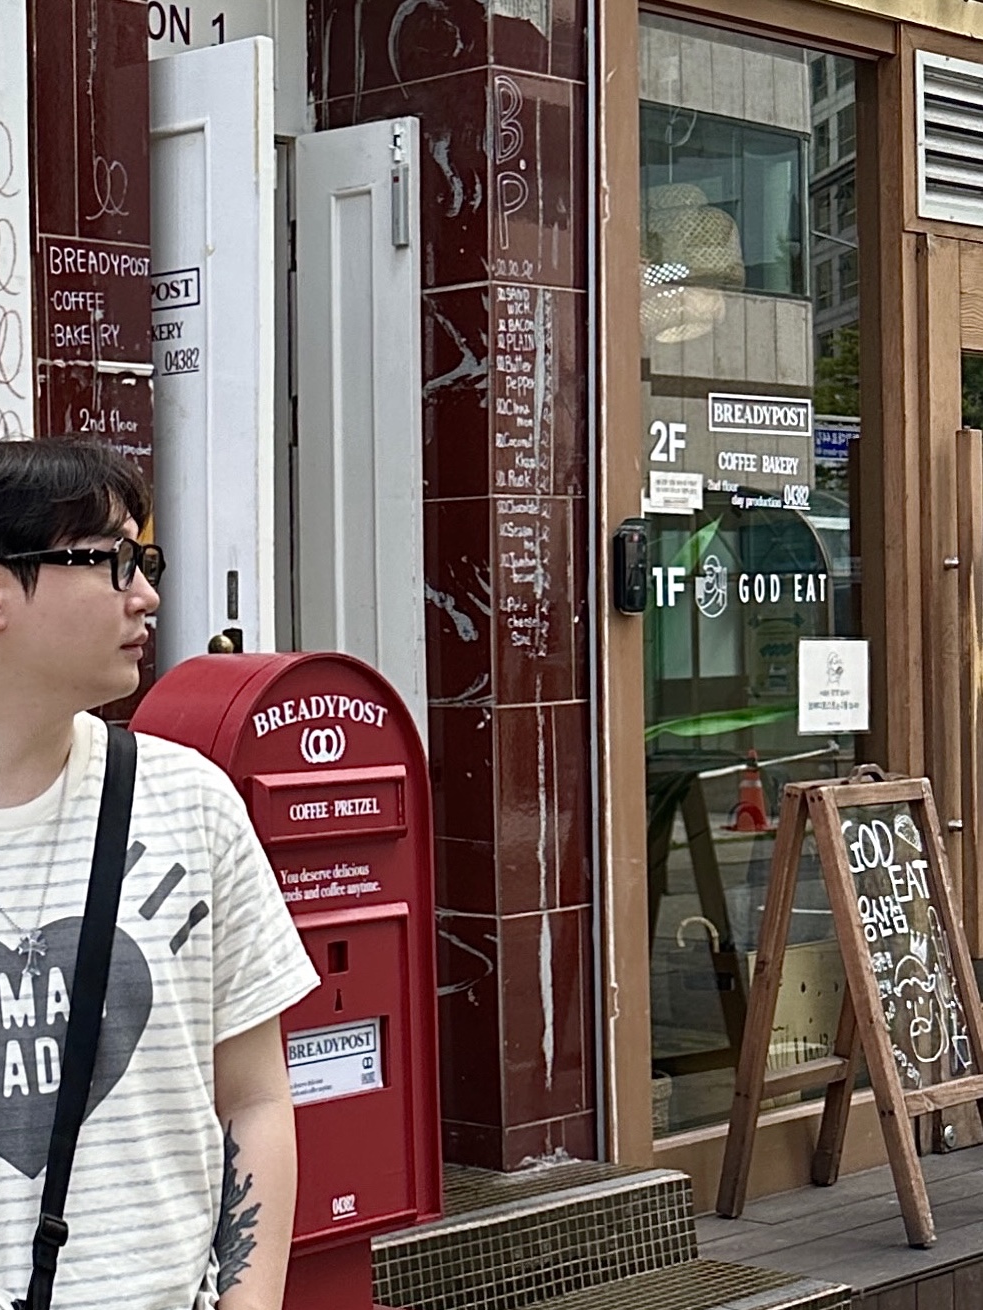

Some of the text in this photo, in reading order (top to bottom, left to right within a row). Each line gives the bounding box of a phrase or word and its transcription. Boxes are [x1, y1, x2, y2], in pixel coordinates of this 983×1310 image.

[148, 1, 190, 45] ON
[49, 246, 151, 277] BREADYPOST
[164, 348, 199, 372] 04382
[80, 408, 139, 433] 2nd floor
[713, 403, 807, 428] BREADYPOST
[650, 421, 687, 462] 2F
[718, 452, 799, 475] COFFEE BAKERY
[783, 484, 811, 508] 04382
[652, 567, 686, 607] 1F
[739, 573, 827, 603] GOD EAT
[252, 695, 388, 738] BREADYPOST
[289, 798, 381, 821] COFFEE PRETZEL
[841, 818, 894, 873] GOD
[280, 862, 370, 885] You deserve delicious
[888, 860, 930, 902] EAT
[304, 884, 320, 900] and
[321, 881, 346, 898] coffee
[288, 1031, 373, 1061] BREADYPOST
